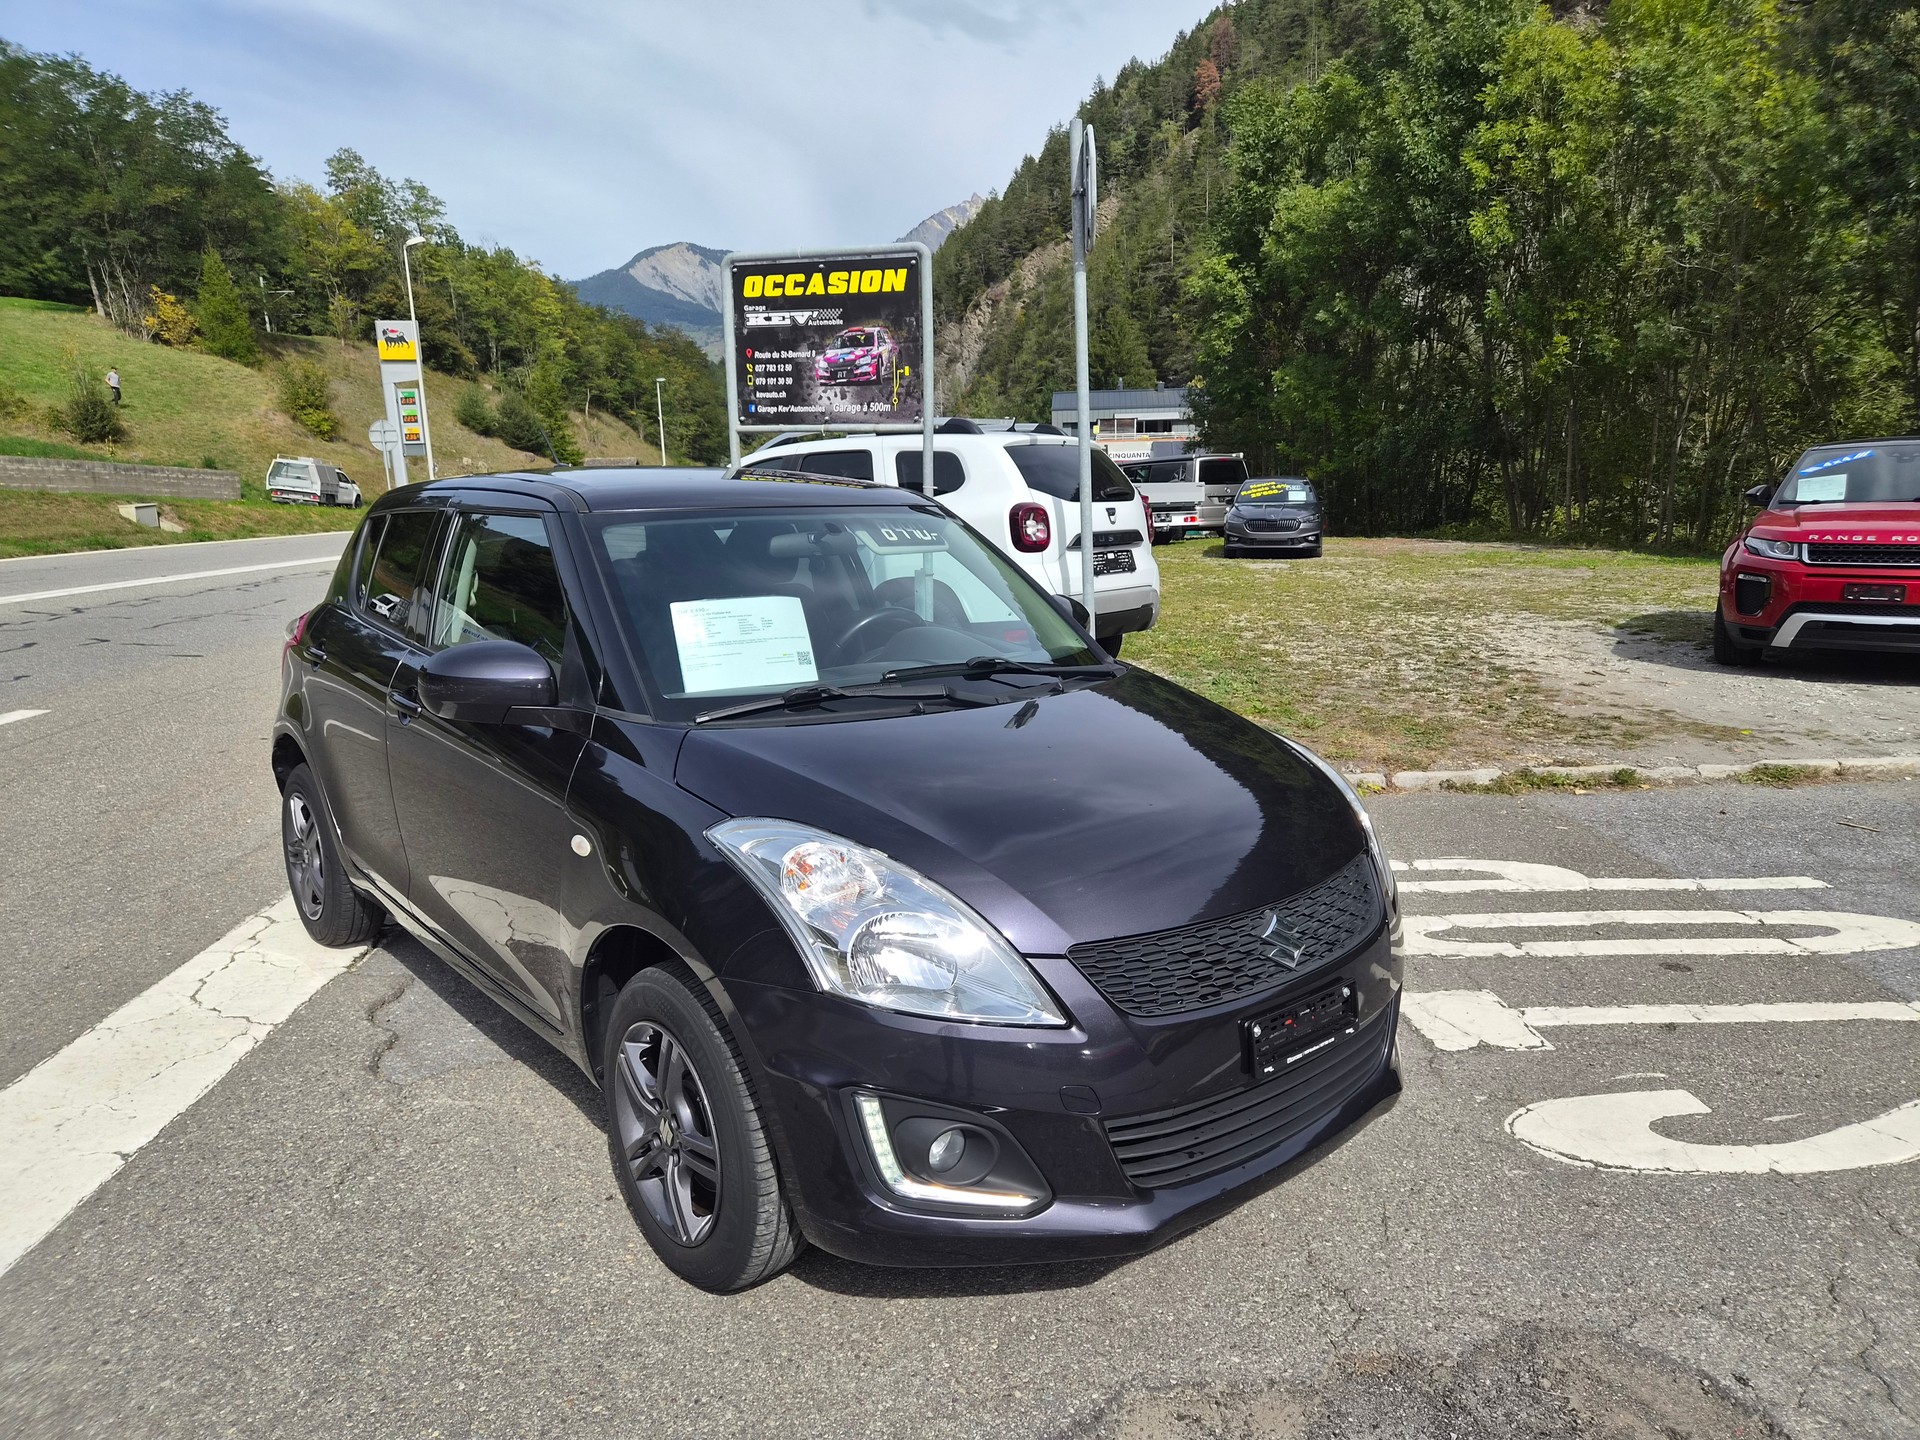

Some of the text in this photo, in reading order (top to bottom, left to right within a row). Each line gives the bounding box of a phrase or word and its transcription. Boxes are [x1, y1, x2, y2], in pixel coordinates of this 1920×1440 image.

[743, 268, 908, 298] OCCASION
[755, 351, 771, 359] Route
[781, 350, 811, 358] St-Bernard
[755, 364, 765, 372] 027
[756, 391, 787, 399] kevauto.ch
[757, 405, 777, 414] Garage
[833, 402, 891, 413] Garage à 500m
